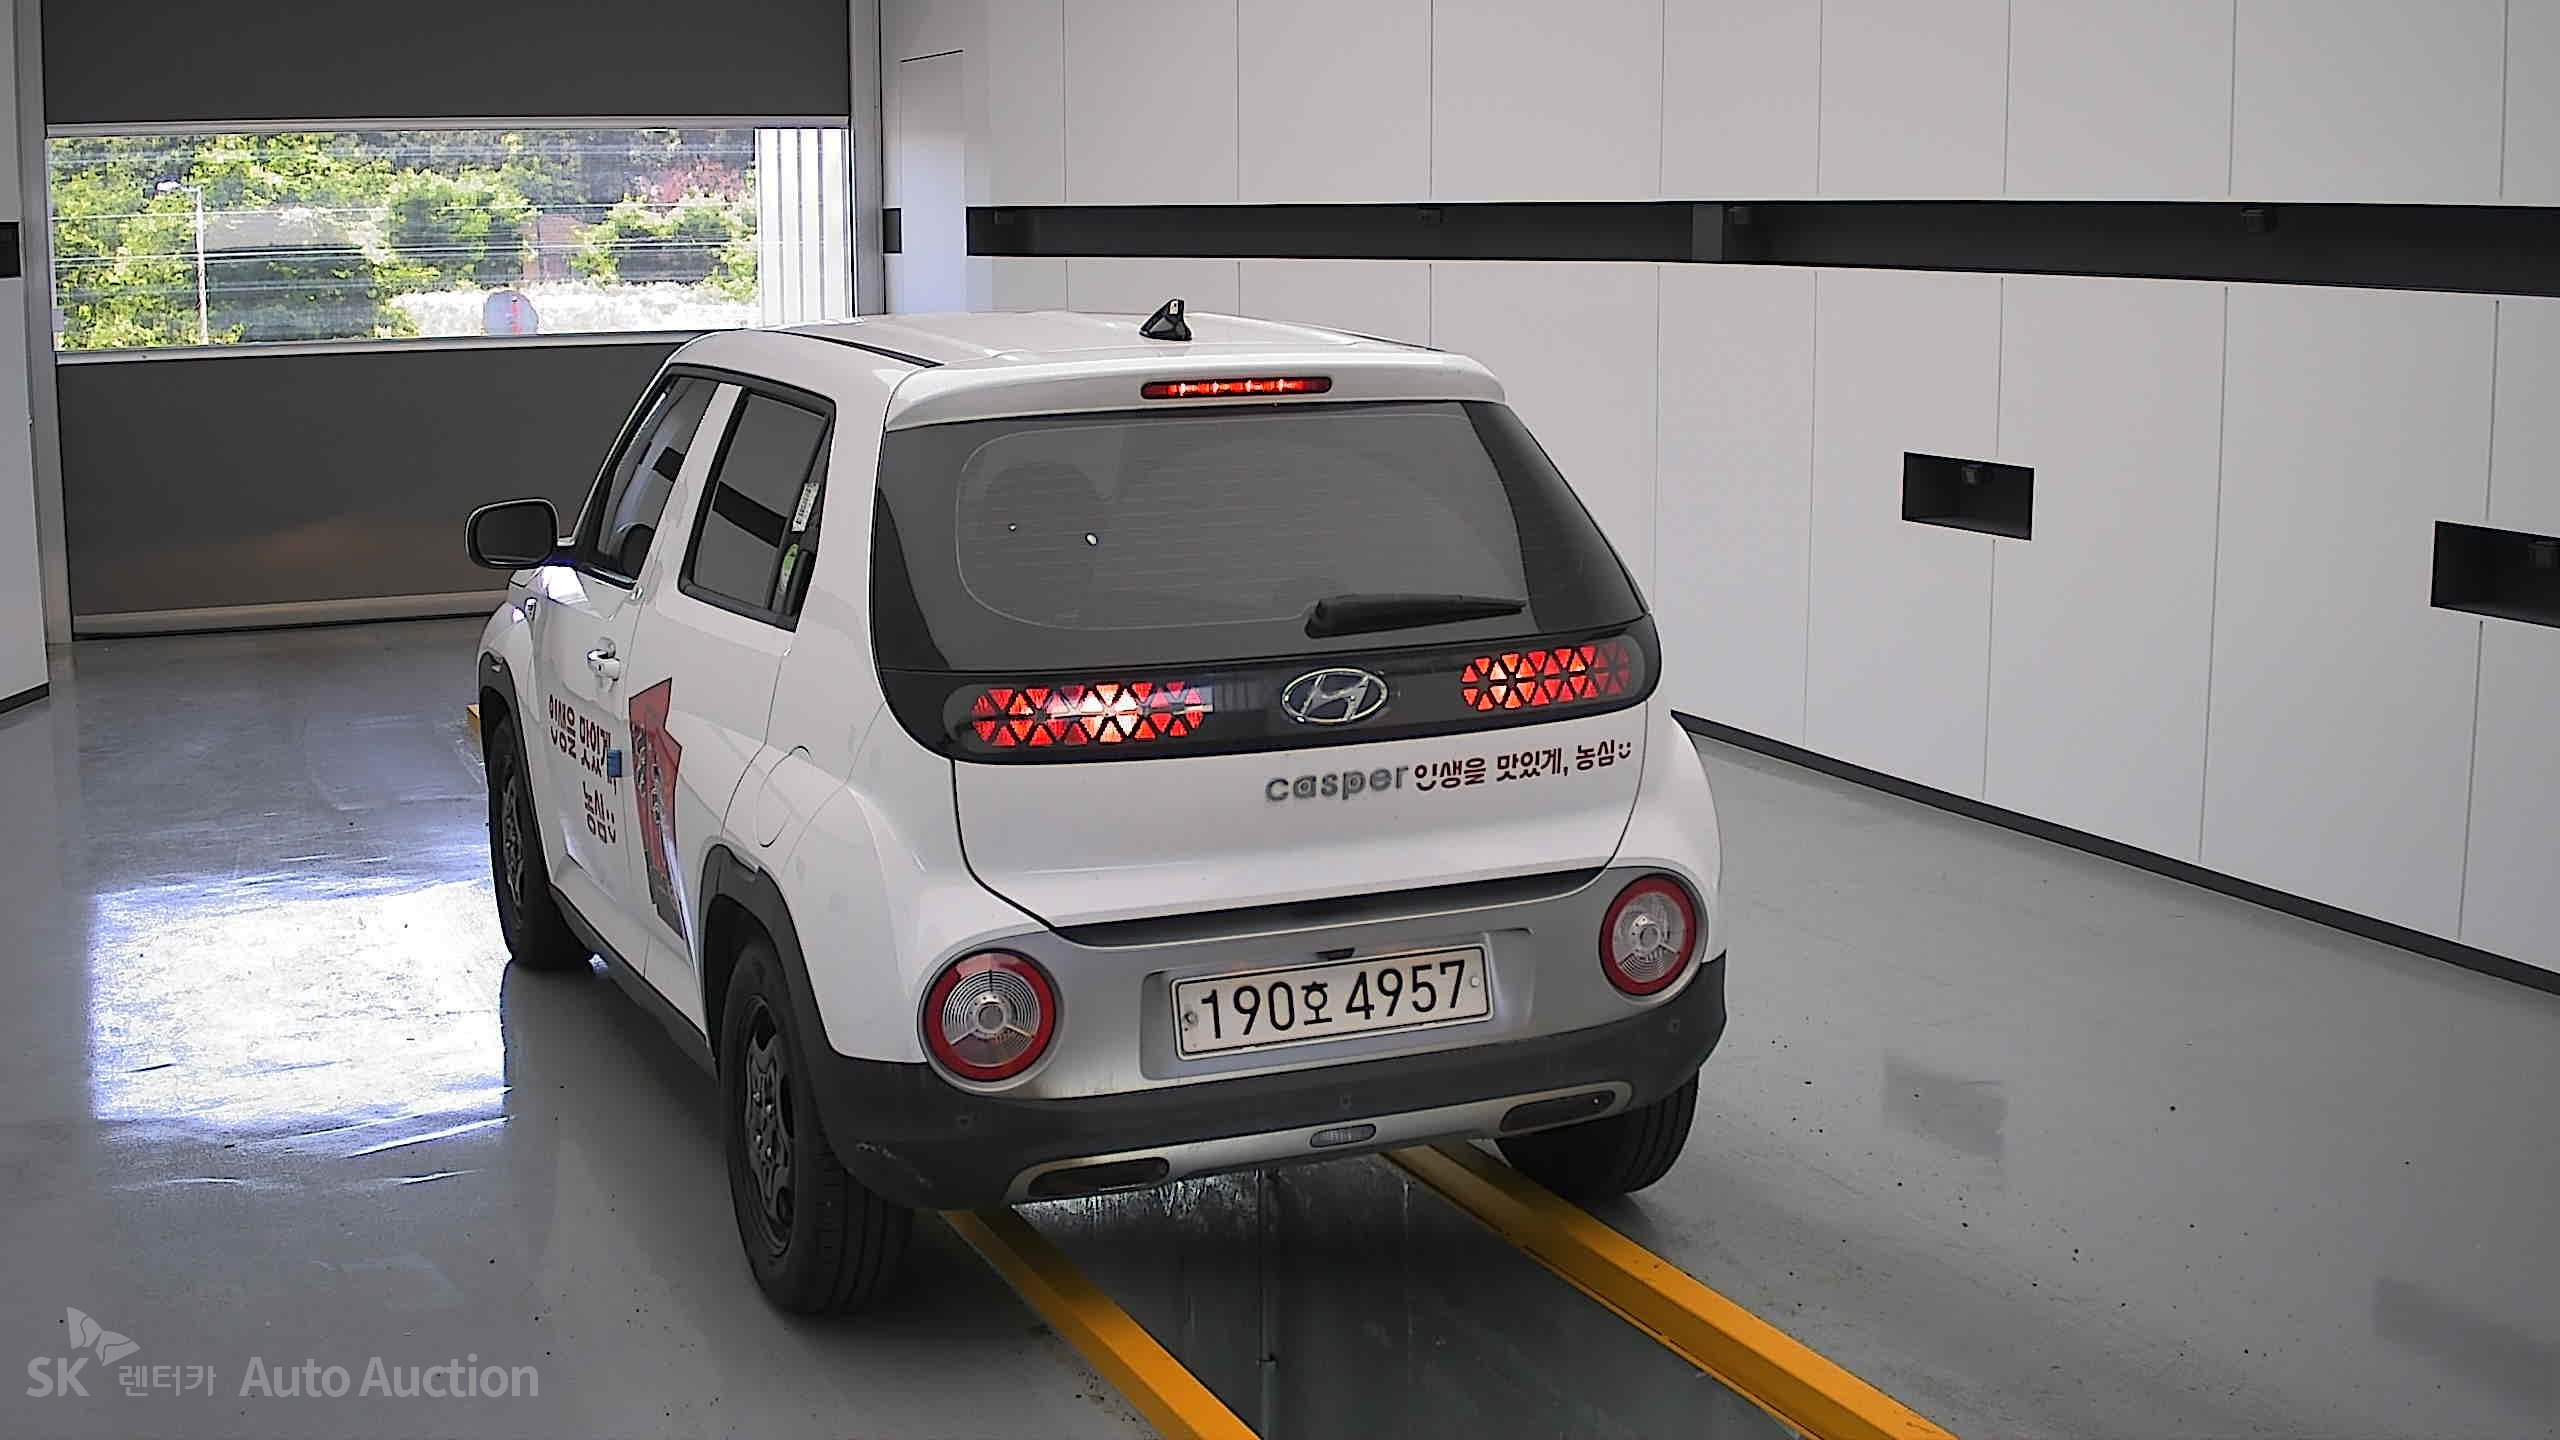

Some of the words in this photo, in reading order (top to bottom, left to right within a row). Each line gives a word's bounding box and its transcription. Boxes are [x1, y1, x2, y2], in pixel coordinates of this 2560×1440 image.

[549, 694, 577, 759] 인생을
[1265, 766, 1409, 802] casper
[1414, 756, 1487, 792] 인생을
[1496, 747, 1569, 782] 맛있게,
[1575, 739, 1616, 772] 농심
[582, 780, 608, 844] 농심
[1201, 981, 1333, 1040] 190호
[1345, 959, 1466, 1021] 4957
